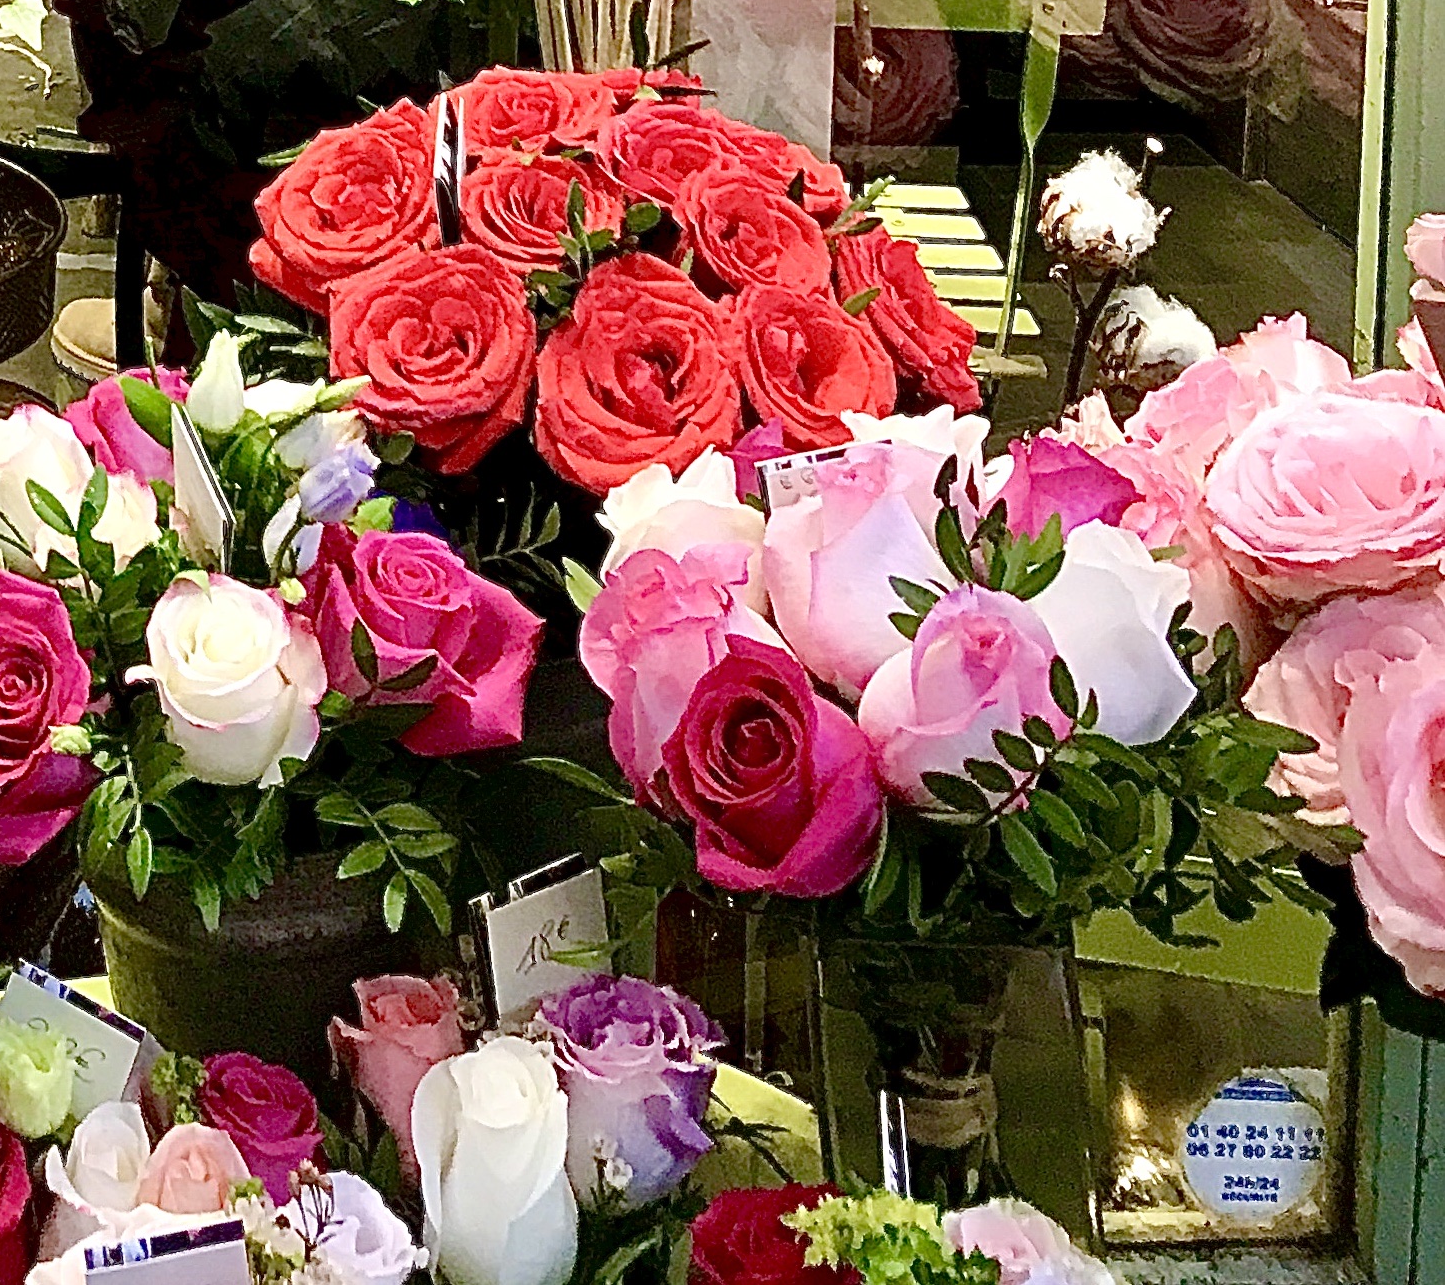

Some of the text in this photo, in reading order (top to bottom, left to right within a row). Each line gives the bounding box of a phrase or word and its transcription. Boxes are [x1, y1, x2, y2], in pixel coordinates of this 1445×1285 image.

[1186, 1122, 1210, 1139] 01
[1216, 1124, 1240, 1139] 40
[1245, 1125, 1269, 1141] 24
[1214, 1143, 1237, 1159] 27
[1270, 1145, 1294, 1160] 22
